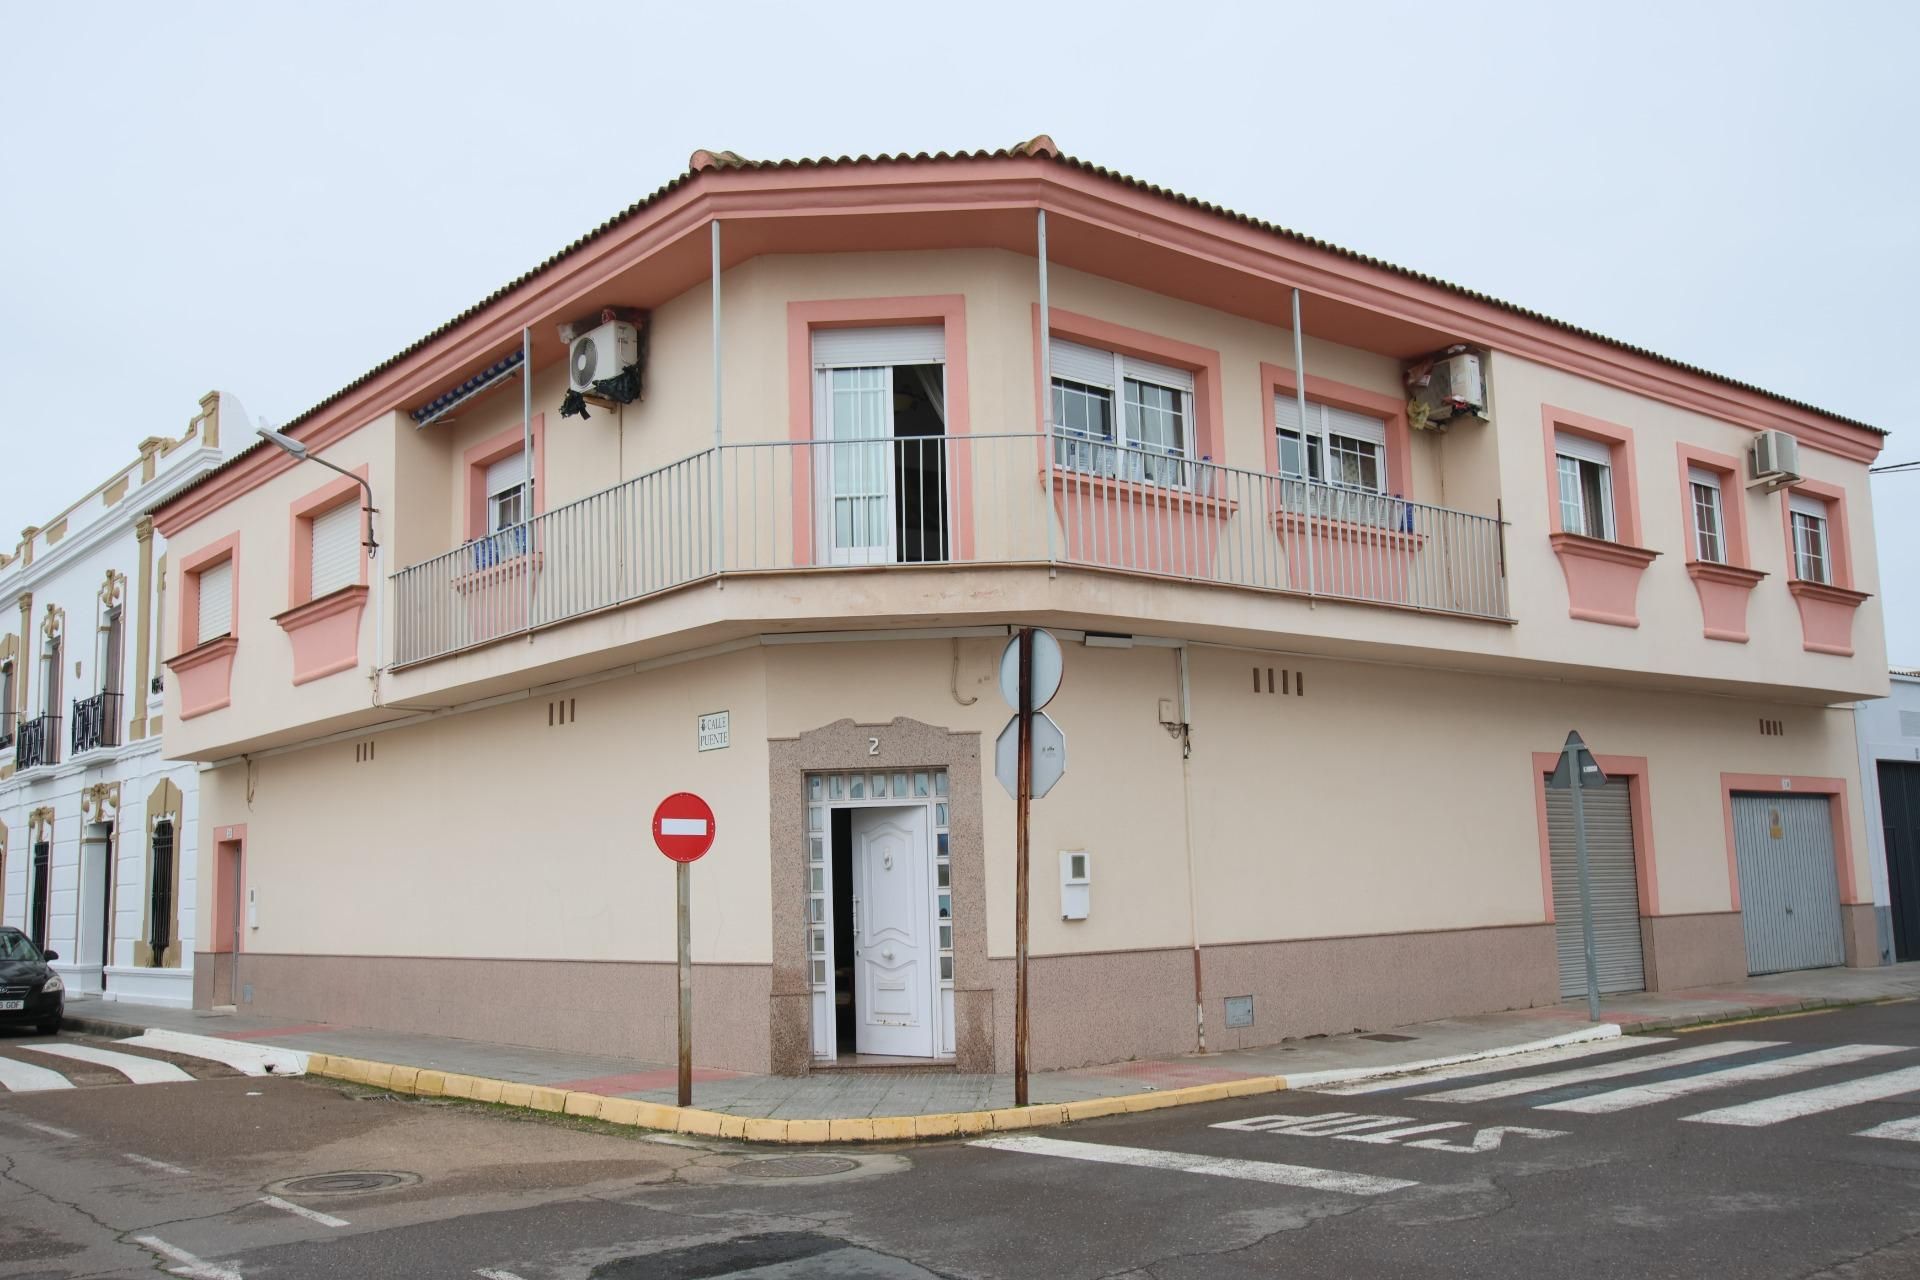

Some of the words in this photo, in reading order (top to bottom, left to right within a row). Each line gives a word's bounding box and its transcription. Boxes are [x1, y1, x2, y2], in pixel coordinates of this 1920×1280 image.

[707, 717, 727, 730] CALLE
[700, 732, 728, 747] PUENTE
[869, 737, 879, 755] 2
[1207, 1112, 1573, 1153] STOP
